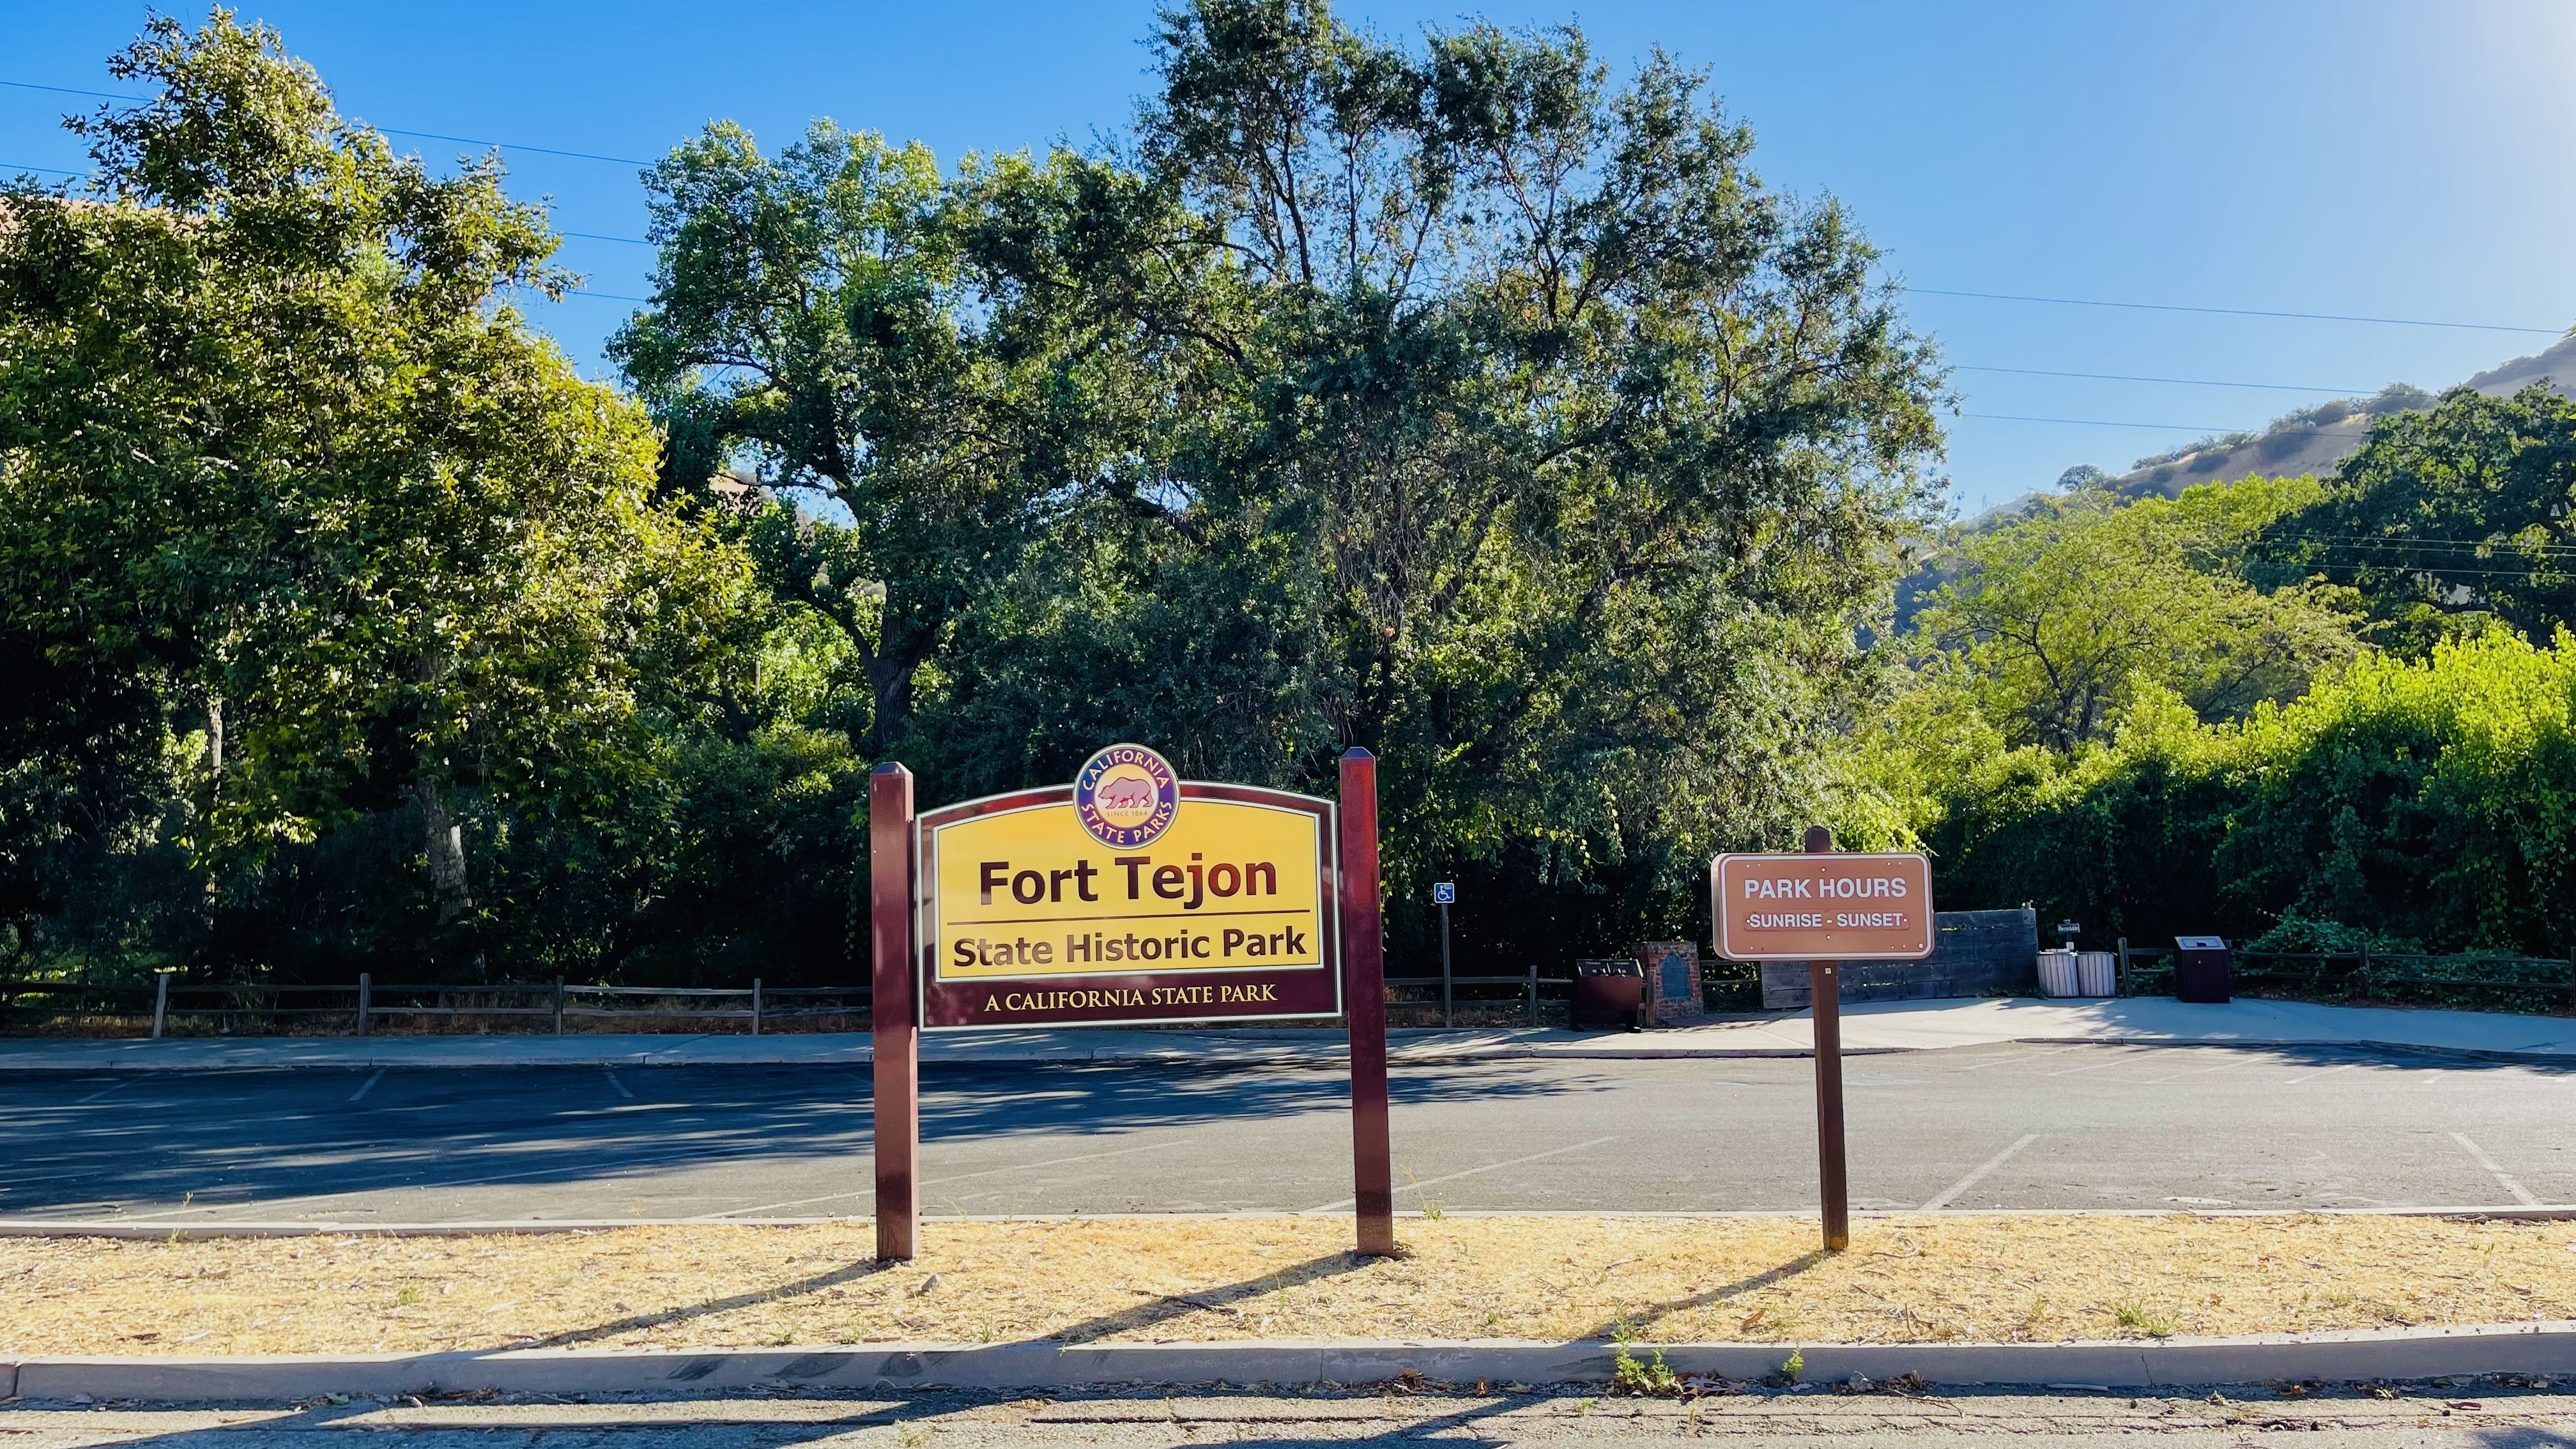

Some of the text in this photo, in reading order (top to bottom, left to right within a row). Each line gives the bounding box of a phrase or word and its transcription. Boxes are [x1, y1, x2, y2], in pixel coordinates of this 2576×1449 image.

[1082, 749, 1170, 791] CALIFORNIA
[1080, 801, 1172, 844] STATE PARKS
[980, 852, 1276, 910] Fort Tejon
[1744, 877, 1908, 899] PARK HOURS
[1749, 913, 1823, 928] SUNRISE
[1836, 912, 1903, 927] SUNSET
[954, 925, 1307, 967] State Historic Park
[984, 984, 1278, 1012] A CALIFORNIA STATE PARK
